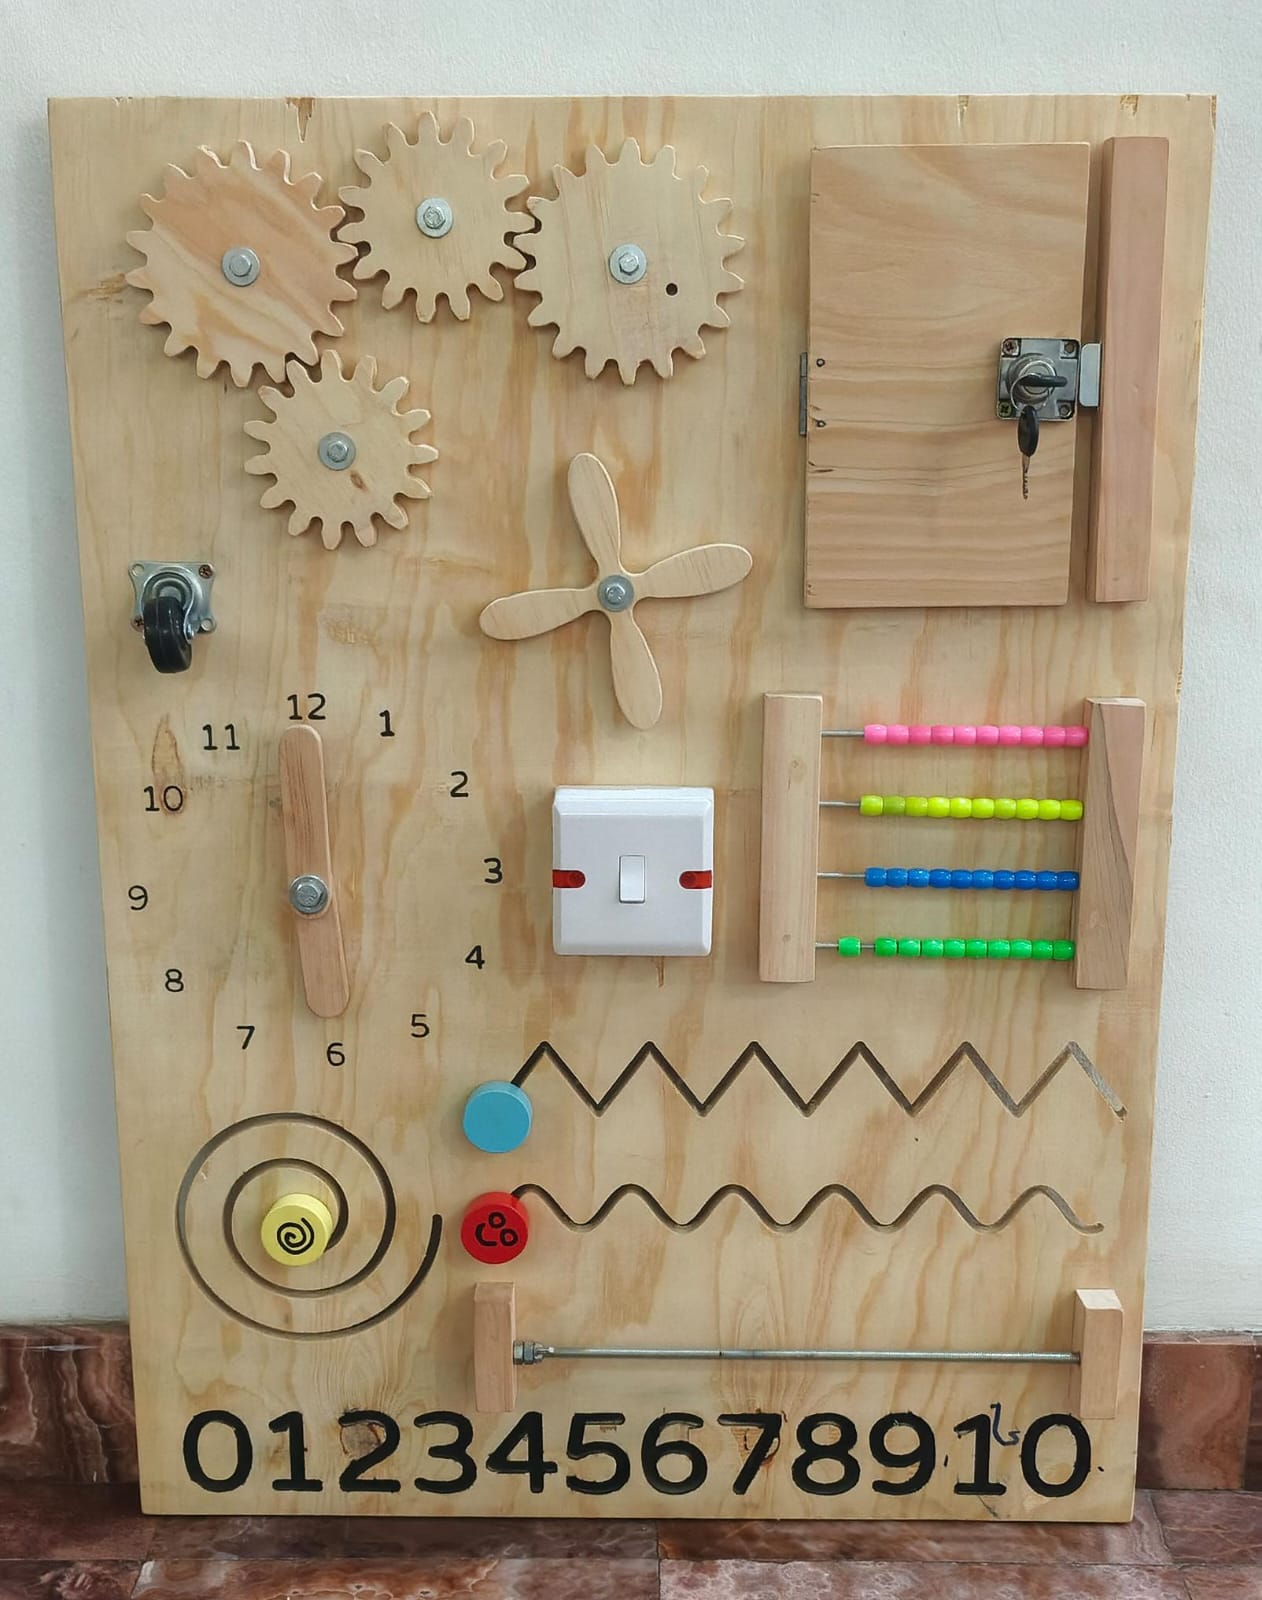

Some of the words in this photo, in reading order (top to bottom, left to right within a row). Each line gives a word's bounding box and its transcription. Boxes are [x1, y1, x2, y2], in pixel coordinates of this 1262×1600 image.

[287, 693, 327, 720] 12
[379, 710, 395, 737] 1
[202, 724, 241, 750] 11
[449, 771, 469, 798] 2
[143, 786, 184, 812] 10
[483, 858, 503, 884] 3
[127, 885, 148, 910] 9
[464, 945, 485, 970] 4
[164, 968, 184, 992] 8
[237, 1025, 255, 1050] 7
[410, 1014, 430, 1038] 5
[326, 1042, 346, 1066] 6
